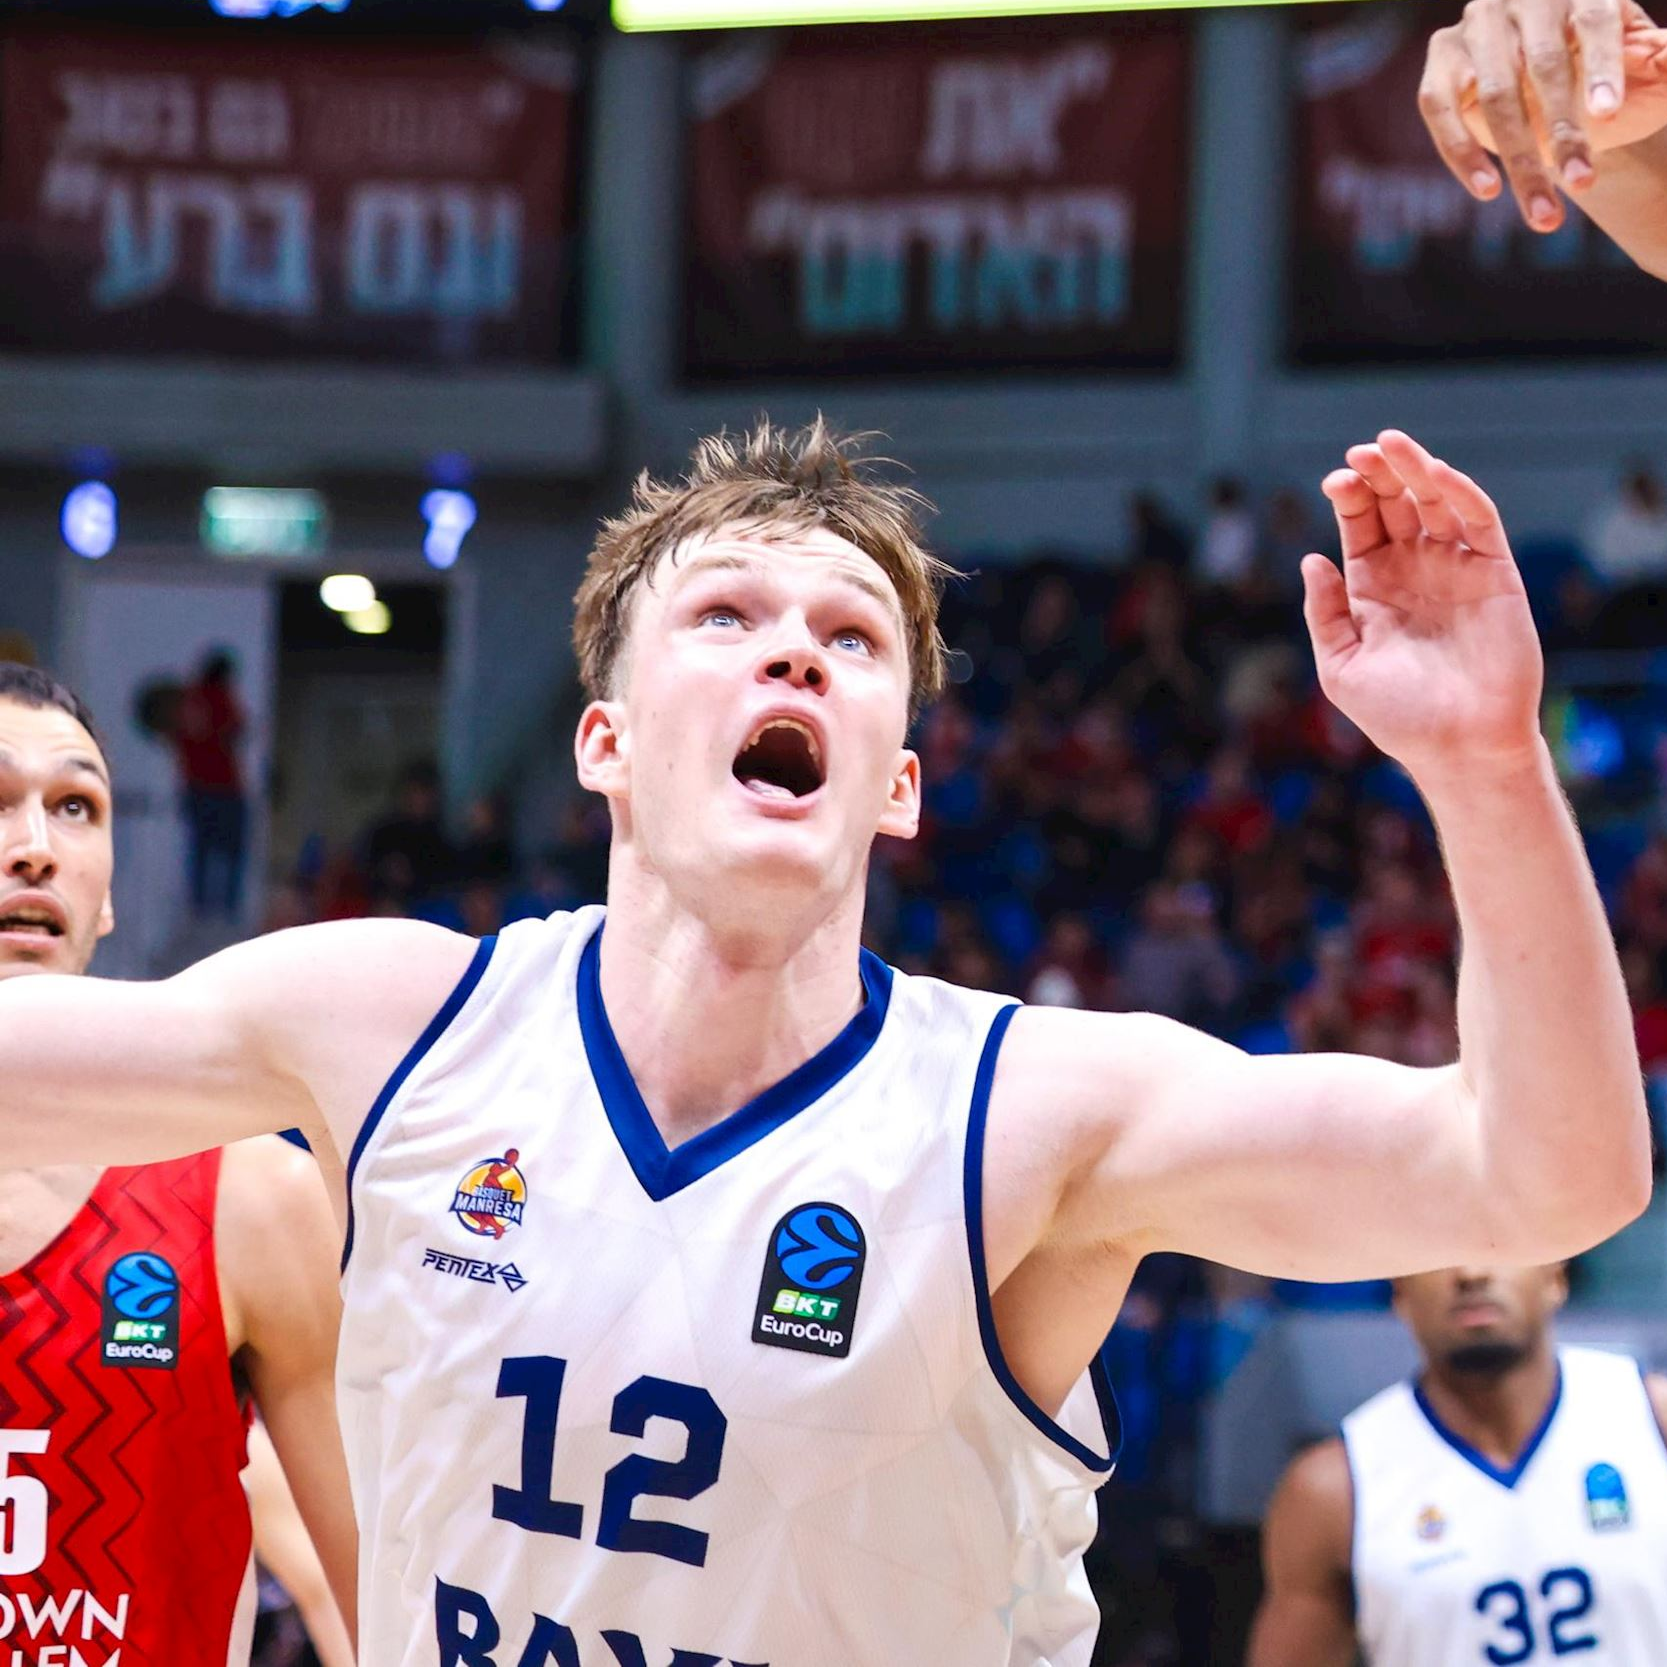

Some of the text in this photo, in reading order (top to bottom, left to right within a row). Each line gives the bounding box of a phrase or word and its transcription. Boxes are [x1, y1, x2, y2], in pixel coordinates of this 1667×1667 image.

[455, 1195, 522, 1222] MANRESA
[773, 1291, 840, 1319] BKT
[114, 1321, 166, 1341] BKT
[760, 1314, 843, 1347] EuroCup
[106, 1342, 174, 1362] EuroCup
[492, 1355, 729, 1568] 12
[1474, 1565, 1598, 1666] 32
